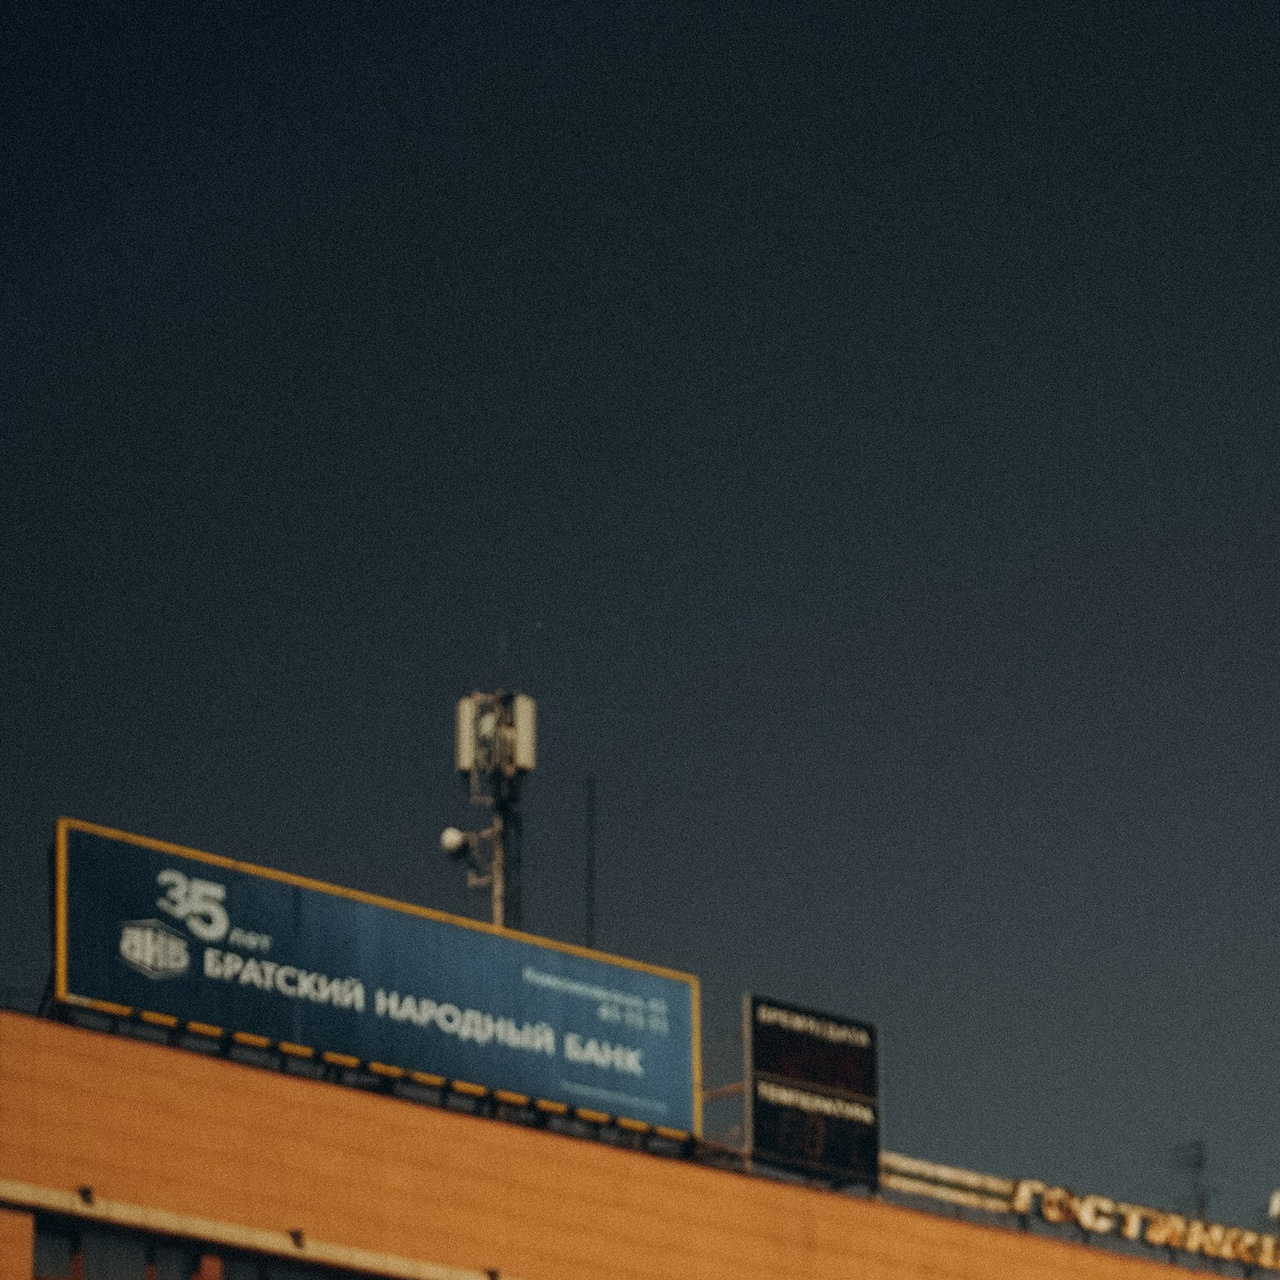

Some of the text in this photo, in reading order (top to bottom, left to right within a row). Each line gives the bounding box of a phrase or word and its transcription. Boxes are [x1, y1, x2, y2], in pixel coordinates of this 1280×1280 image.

[157, 869, 229, 941] 35
[203, 948, 365, 1012] БРАТСКИЙ
[375, 988, 556, 1054] НАРОДНЫЙ
[564, 1033, 645, 1075] БАНК
